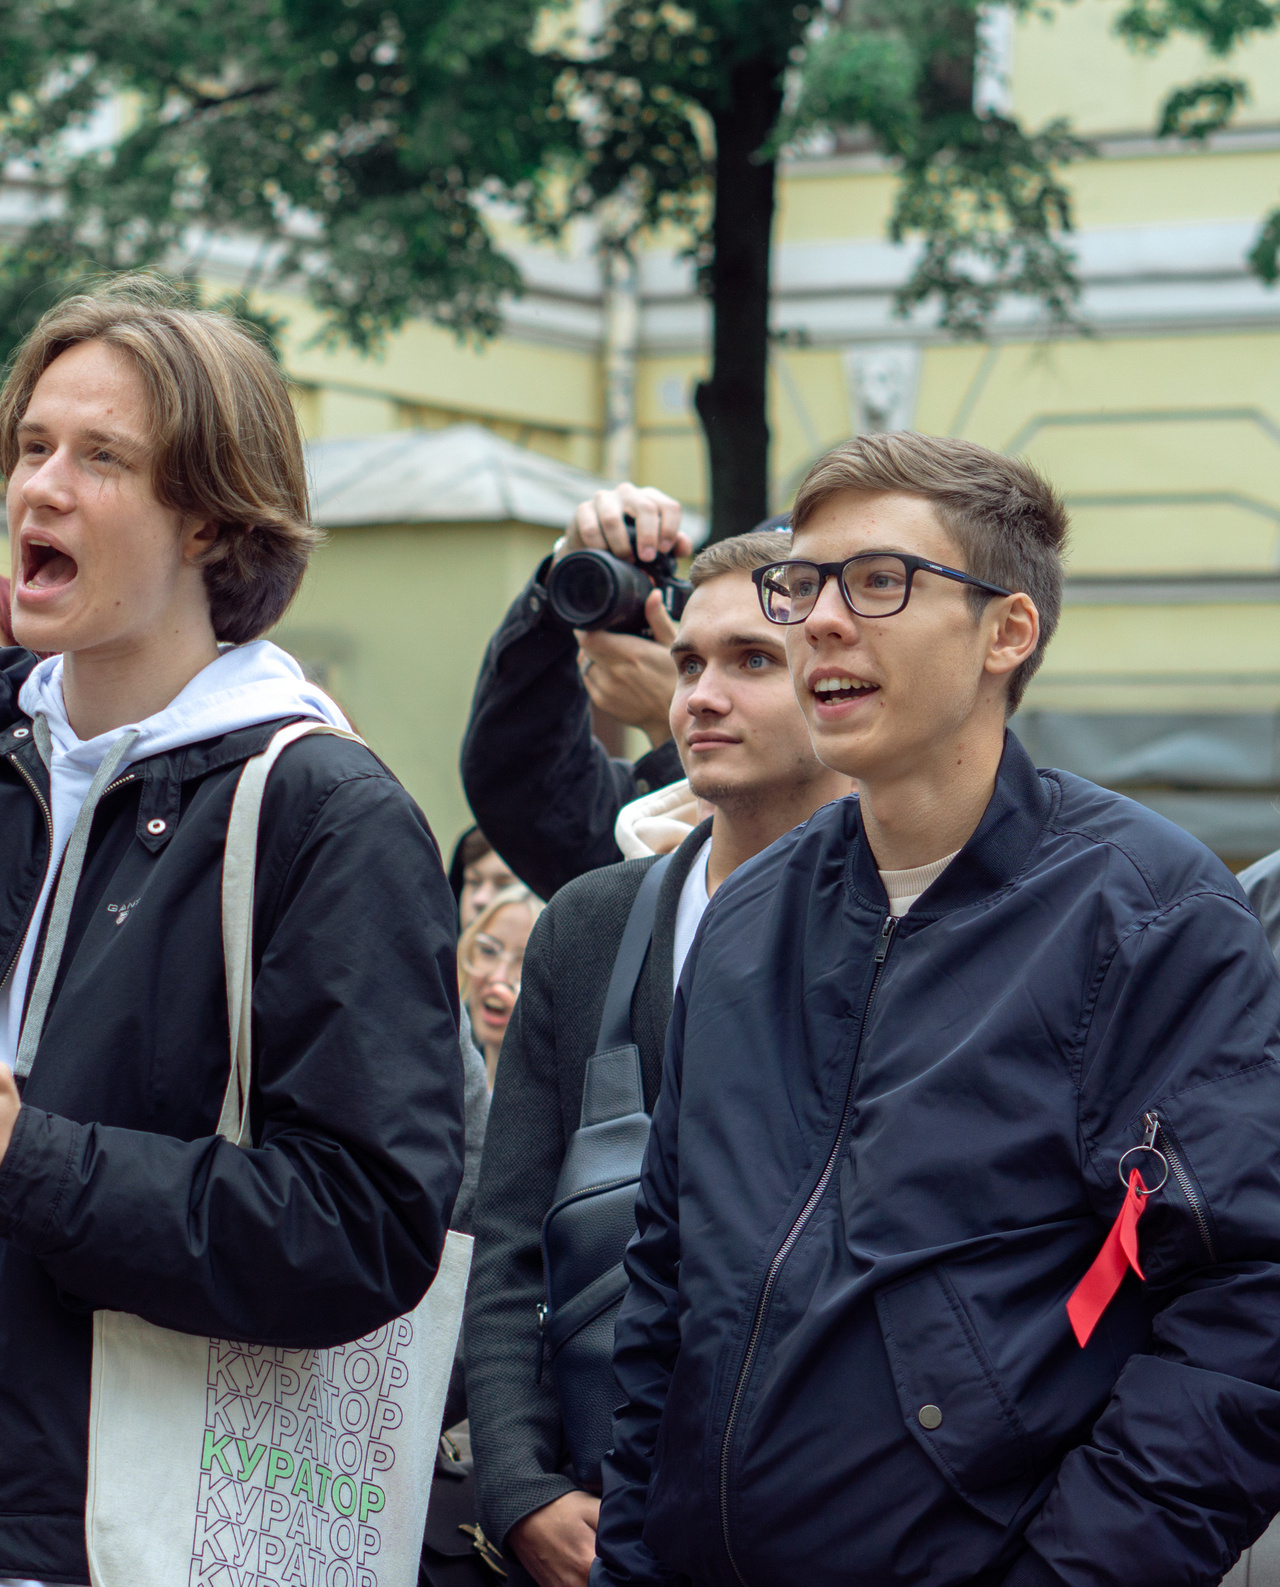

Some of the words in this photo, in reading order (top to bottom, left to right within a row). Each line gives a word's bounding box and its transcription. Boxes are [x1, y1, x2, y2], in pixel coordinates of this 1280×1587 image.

[204, 1387, 396, 1482] КУРАТОР
[206, 1345, 404, 1440] КУРАТОР
[196, 1472, 382, 1565] КУРАТОР
[200, 1429, 386, 1523] КУРАТОР
